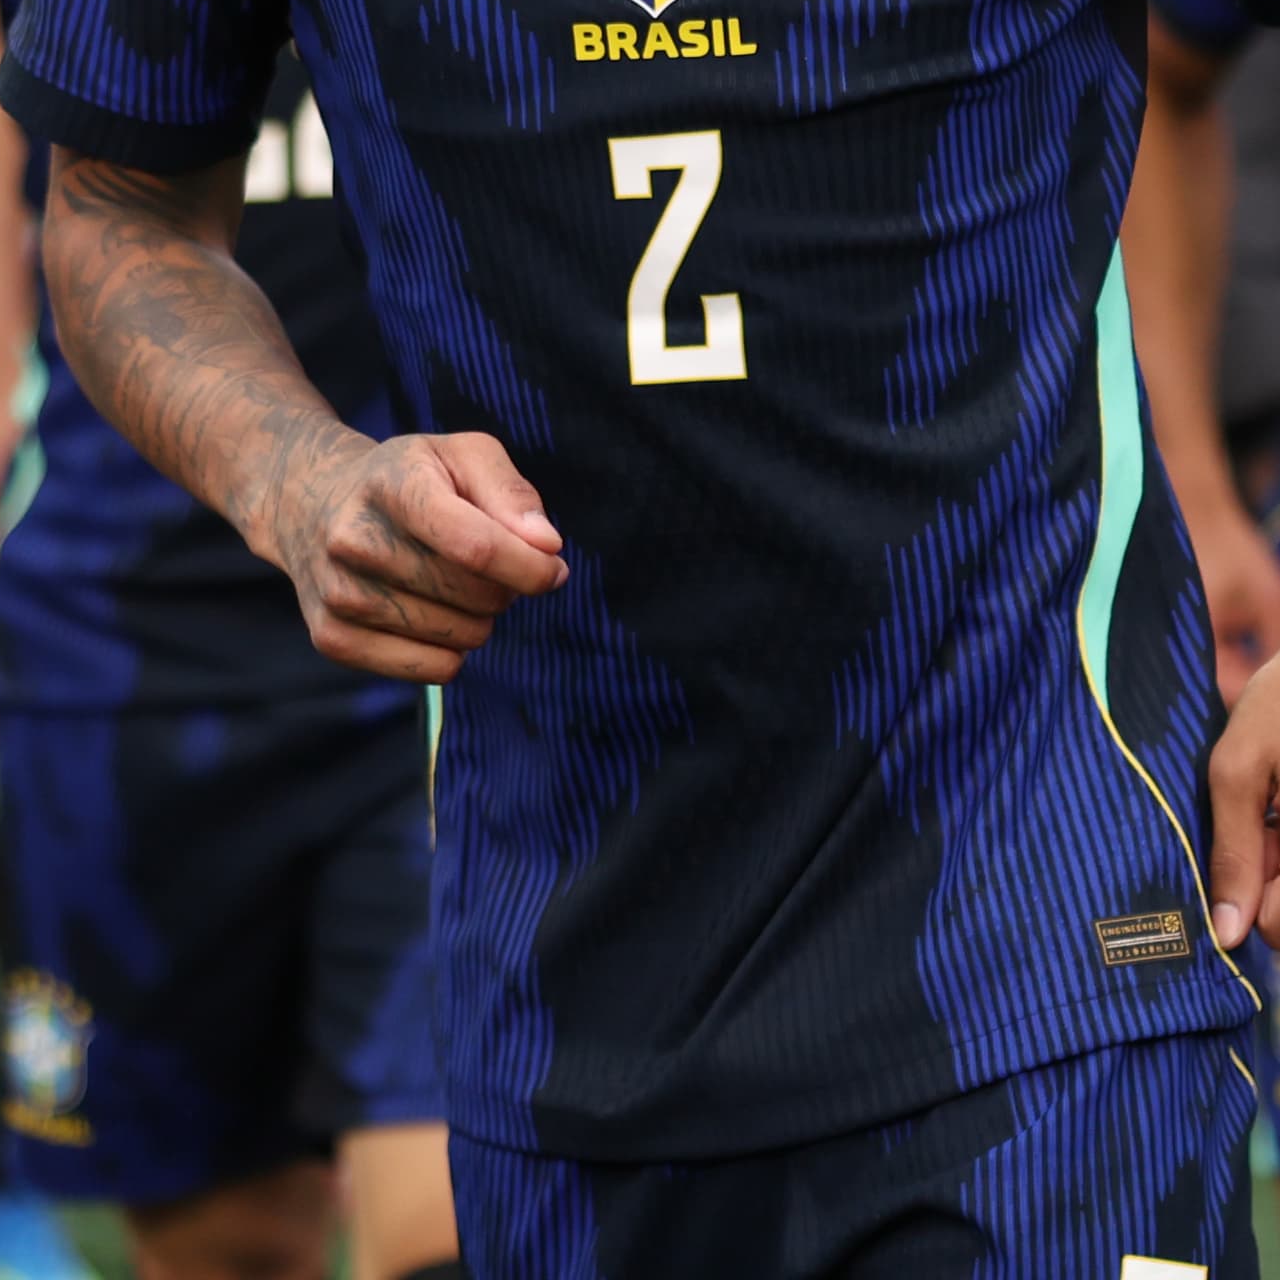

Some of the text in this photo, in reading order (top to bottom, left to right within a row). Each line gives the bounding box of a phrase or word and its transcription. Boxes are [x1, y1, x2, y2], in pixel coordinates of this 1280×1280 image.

[573, 18, 757, 61] BRASIL
[607, 129, 748, 385] 2
[1102, 921, 1160, 937] ENGINEERED
